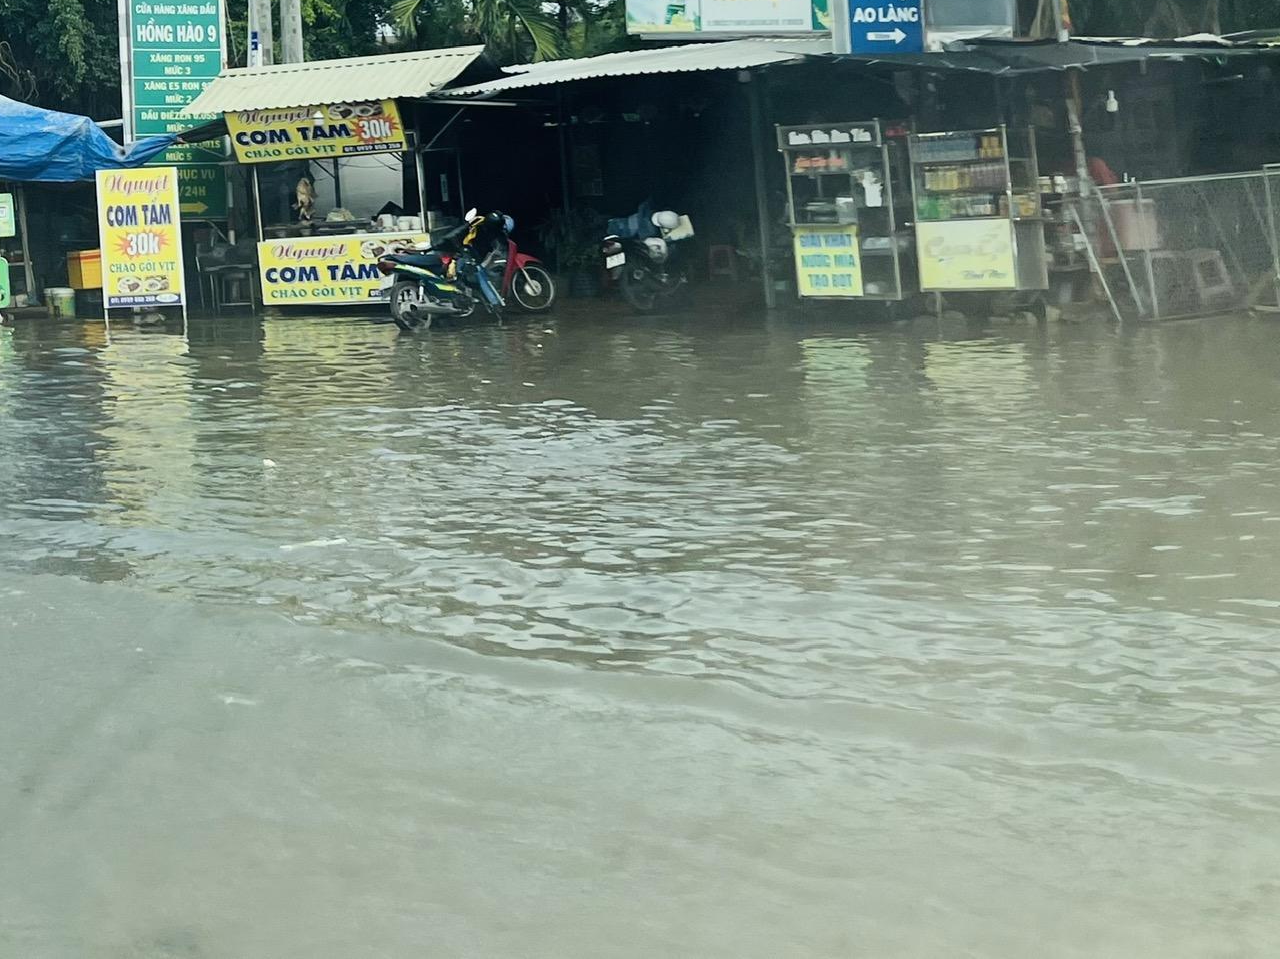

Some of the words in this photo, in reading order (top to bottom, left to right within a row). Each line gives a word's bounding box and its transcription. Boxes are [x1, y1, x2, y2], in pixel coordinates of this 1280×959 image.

[853, 8, 877, 23] AO
[878, 3, 919, 23] LÀNG
[136, 17, 173, 42] HỒNG
[176, 21, 204, 42] HÀO
[207, 25, 216, 42] 9
[174, 54, 192, 63] RON
[193, 54, 205, 63] 95
[182, 82, 200, 90] RON
